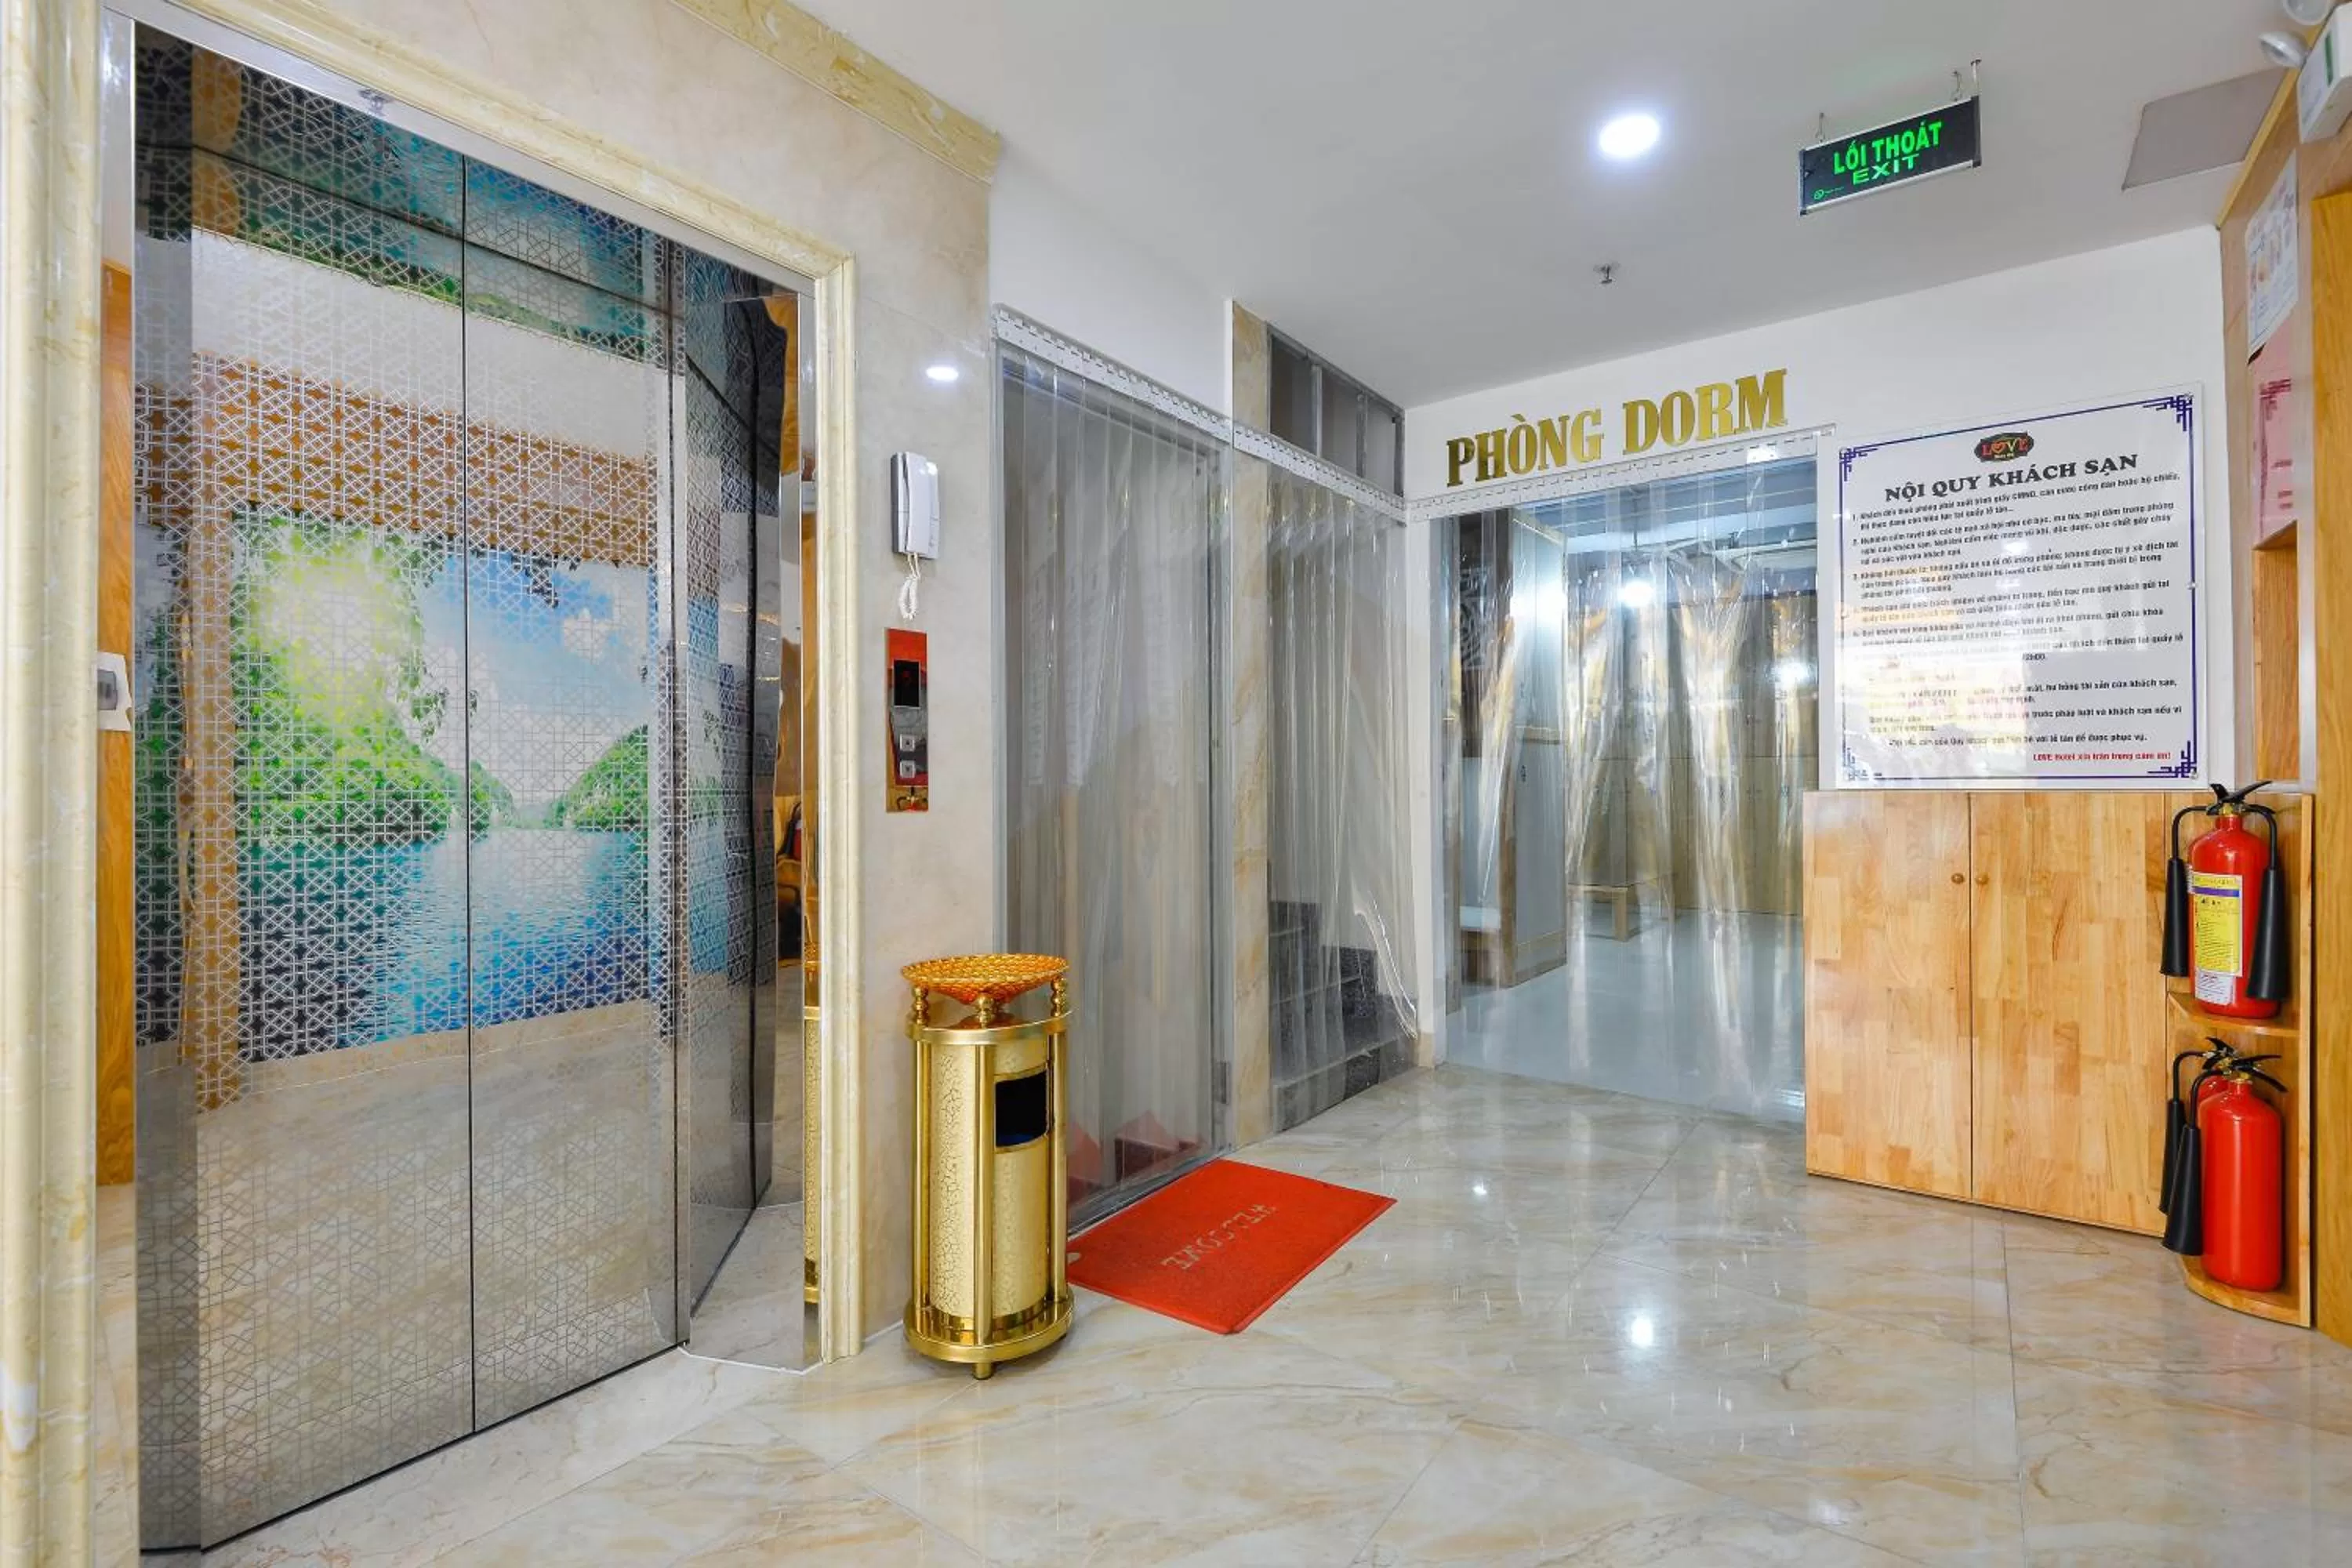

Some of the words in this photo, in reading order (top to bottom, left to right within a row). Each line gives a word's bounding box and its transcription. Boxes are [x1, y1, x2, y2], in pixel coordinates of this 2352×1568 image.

[1834, 140, 1866, 175] LỐI
[1872, 122, 1943, 162] THOÁT
[1853, 154, 1919, 185] EXIT
[1446, 408, 1605, 488] PHÒNG
[1622, 368, 1788, 455] DORM
[1885, 481, 1925, 502] NỘI
[1932, 476, 1980, 497] QUY
[1988, 462, 2077, 488] KHÁCH
[2085, 454, 2138, 476] SẠN
